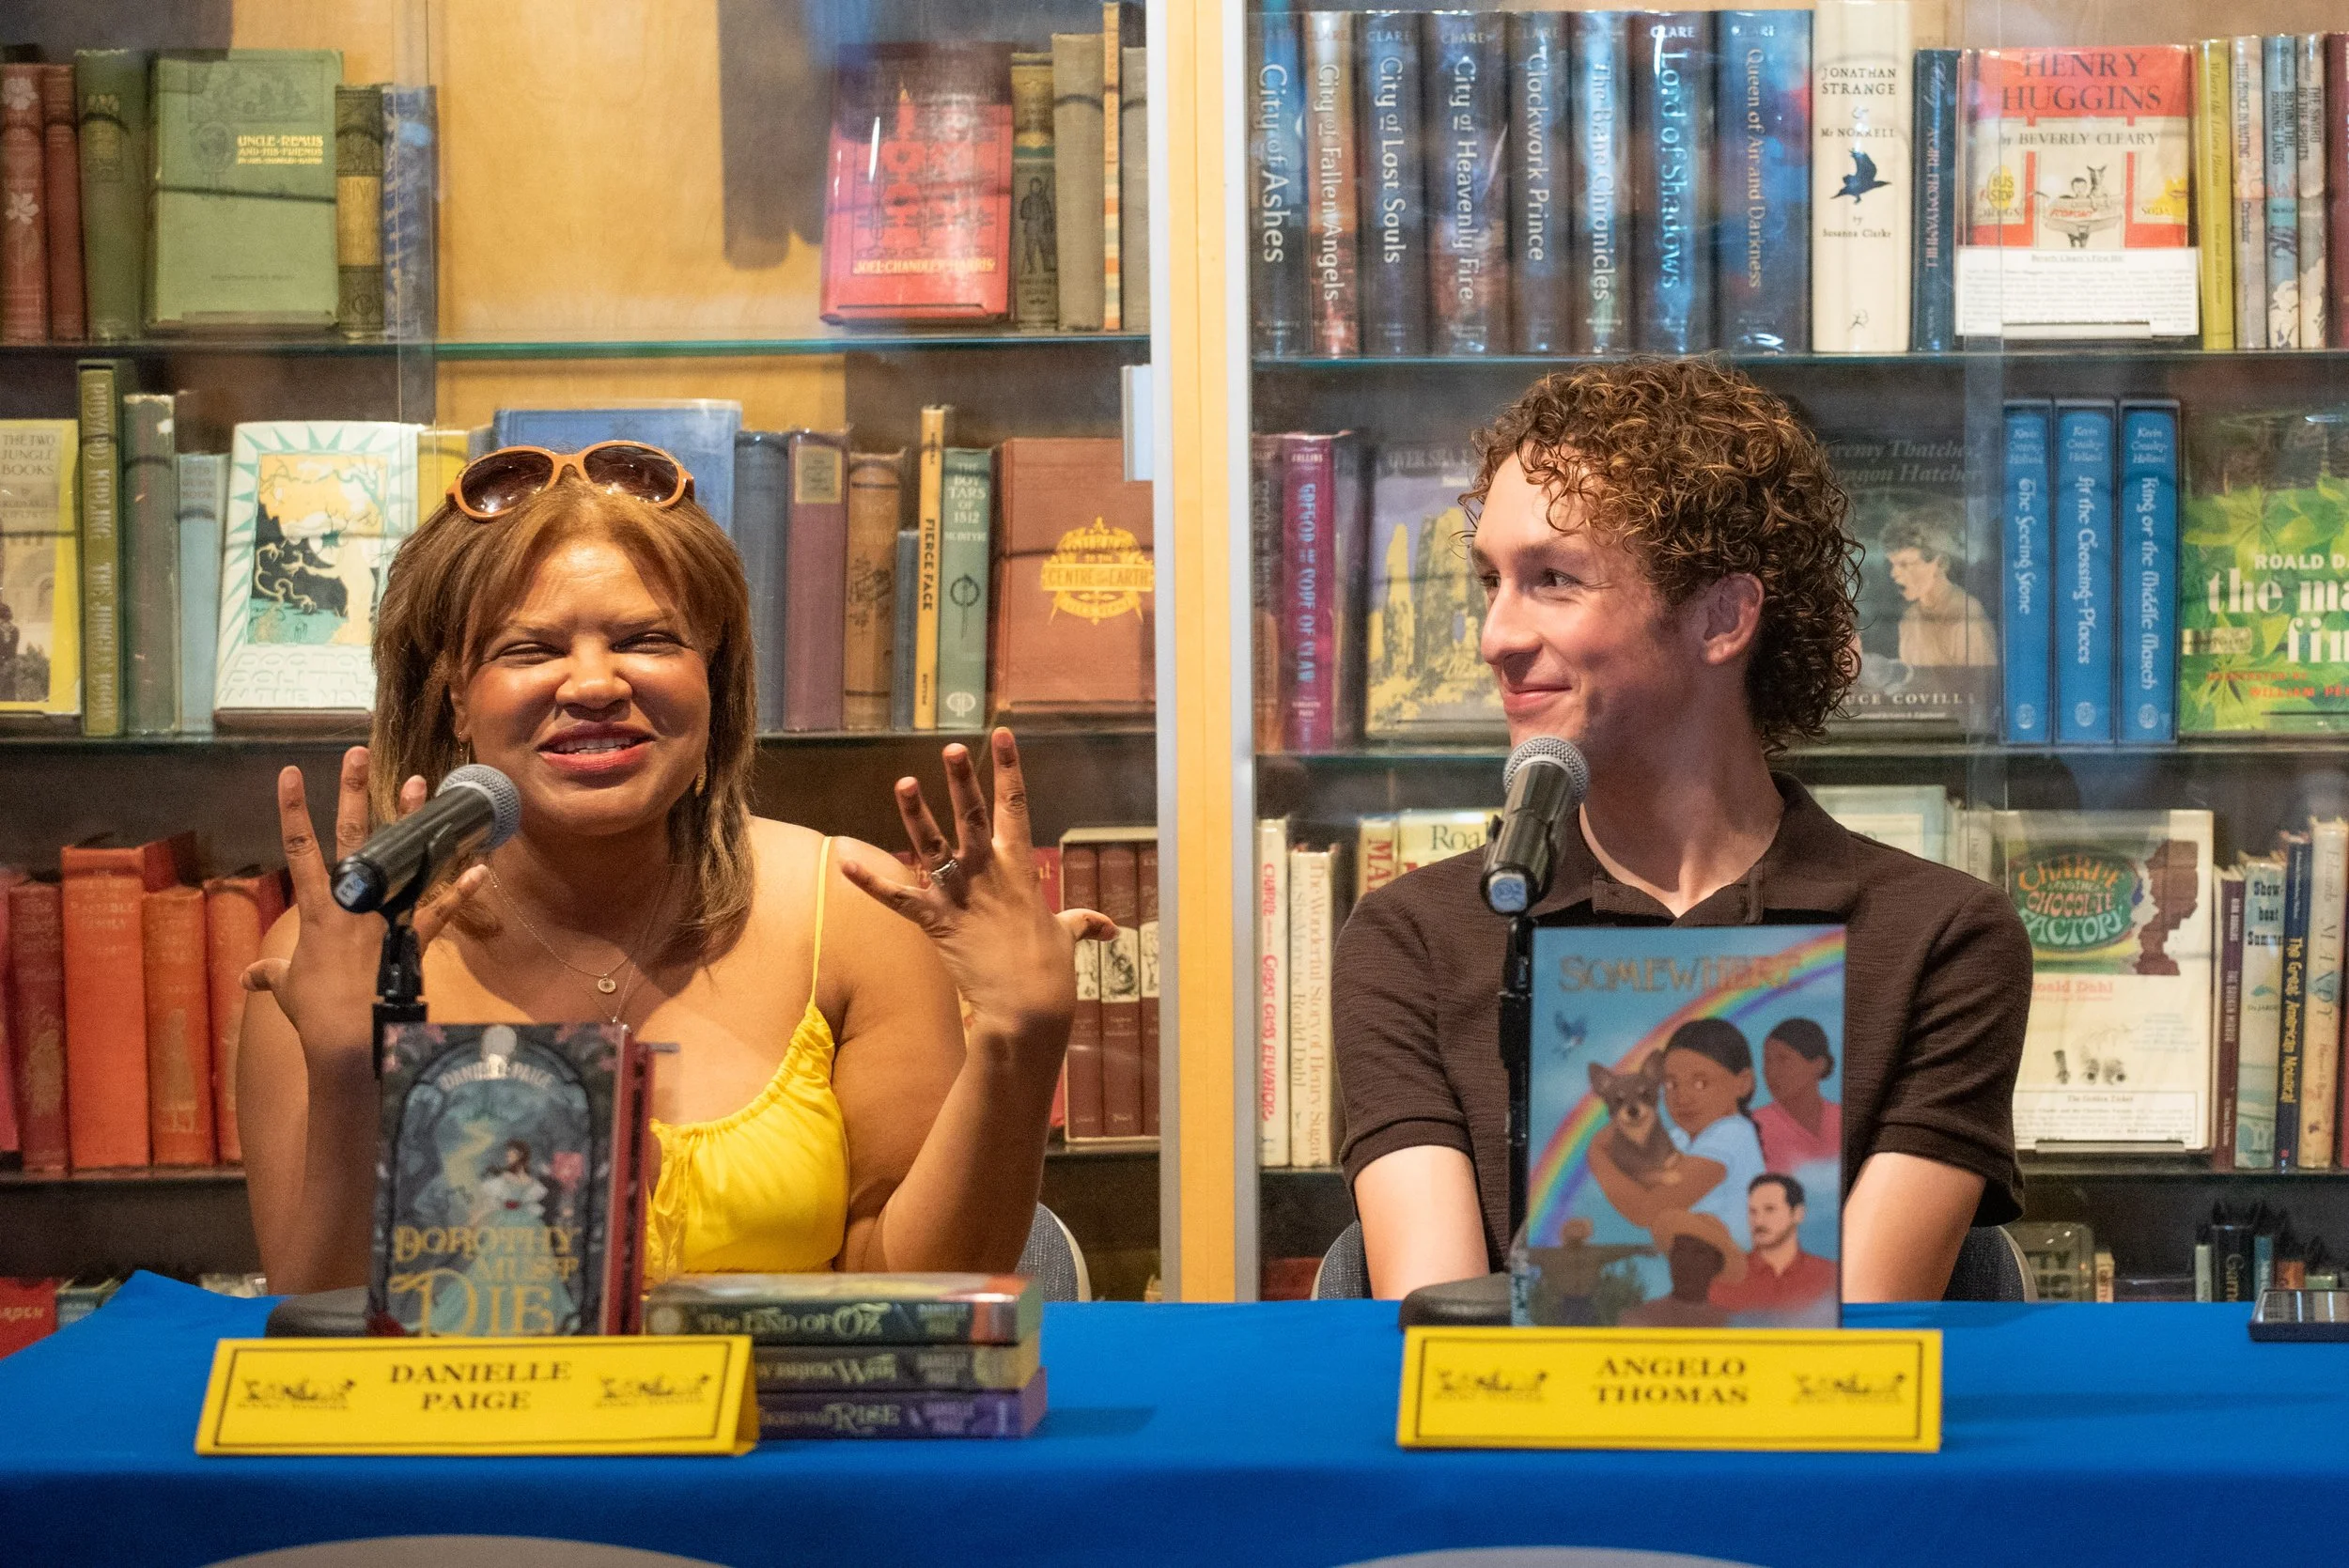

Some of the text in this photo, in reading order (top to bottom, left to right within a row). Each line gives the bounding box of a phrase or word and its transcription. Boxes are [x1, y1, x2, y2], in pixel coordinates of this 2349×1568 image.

[1368, 30, 1409, 42] CLARE
[1441, 33, 1485, 44] CLARE
[1821, 68, 1896, 79] JONATHAN
[2024, 53, 2145, 77] HENRY
[1314, 64, 1340, 112] City
[1822, 83, 1896, 95] STRANGE
[2002, 85, 2161, 110] HUGGINS
[237, 135, 323, 147] UNCLE REMUS
[1318, 117, 1338, 136] of
[1593, 106, 1612, 158] Bane
[1837, 128, 1895, 137] NORRELL
[2019, 132, 2090, 145] BEVERLY
[2096, 132, 2158, 145] CLEARY
[1256, 64, 1291, 263] City of Ashes
[1374, 56, 1406, 264] City of Lost Souls
[1527, 52, 1549, 261] Clockwork Prince
[1661, 52, 1688, 288] Lord of Shadows
[1747, 49, 1766, 288] Queen of Air and Darkness
[1320, 147, 1343, 215] Fallen
[1448, 57, 1480, 301] City of Heavenly Fire
[1593, 166, 1615, 301] Chronicles
[1318, 218, 1345, 301] Angels
[2, 464, 54, 475] BOOKS
[947, 487, 987, 500] TARS
[2017, 477, 2037, 511] The
[2078, 498, 2095, 524] the
[2137, 477, 2159, 513] King
[2014, 516, 2037, 569] Seeing
[2141, 540, 2159, 567] the
[923, 519, 936, 611] FIERCE FACE
[2255, 553, 2325, 570] ROALD
[2015, 572, 2037, 614] Stone
[2073, 528, 2098, 664] Crossing-Places
[2141, 571, 2160, 629] Middle
[2208, 567, 2284, 614] the
[226, 670, 370, 686] DOLITTL
[2141, 633, 2160, 690] March
[255, 689, 309, 703] THE
[318, 689, 374, 703] MOO
[2249, 687, 2315, 697] WILLIAM
[1430, 822, 1489, 851] Roal
[1367, 838, 1394, 893] MA
[2019, 905, 2124, 945] FACTORY
[2286, 938, 2303, 958] The
[2032, 979, 2071, 993] oald
[2284, 961, 2302, 996] Great
[1293, 993, 1306, 1041] Roald
[1308, 862, 1325, 1161] The Wonderful Story of Henry Sugar
[1293, 1047, 1306, 1088] Dahl
[394, 1226, 583, 1263] DOROTHY
[386, 1268, 556, 1336] DIE
[389, 1361, 571, 1385] DANIELLE
[1600, 1356, 1746, 1378] ANGELO
[420, 1390, 531, 1411] PAIGE
[1594, 1384, 1749, 1405] THOMAS
